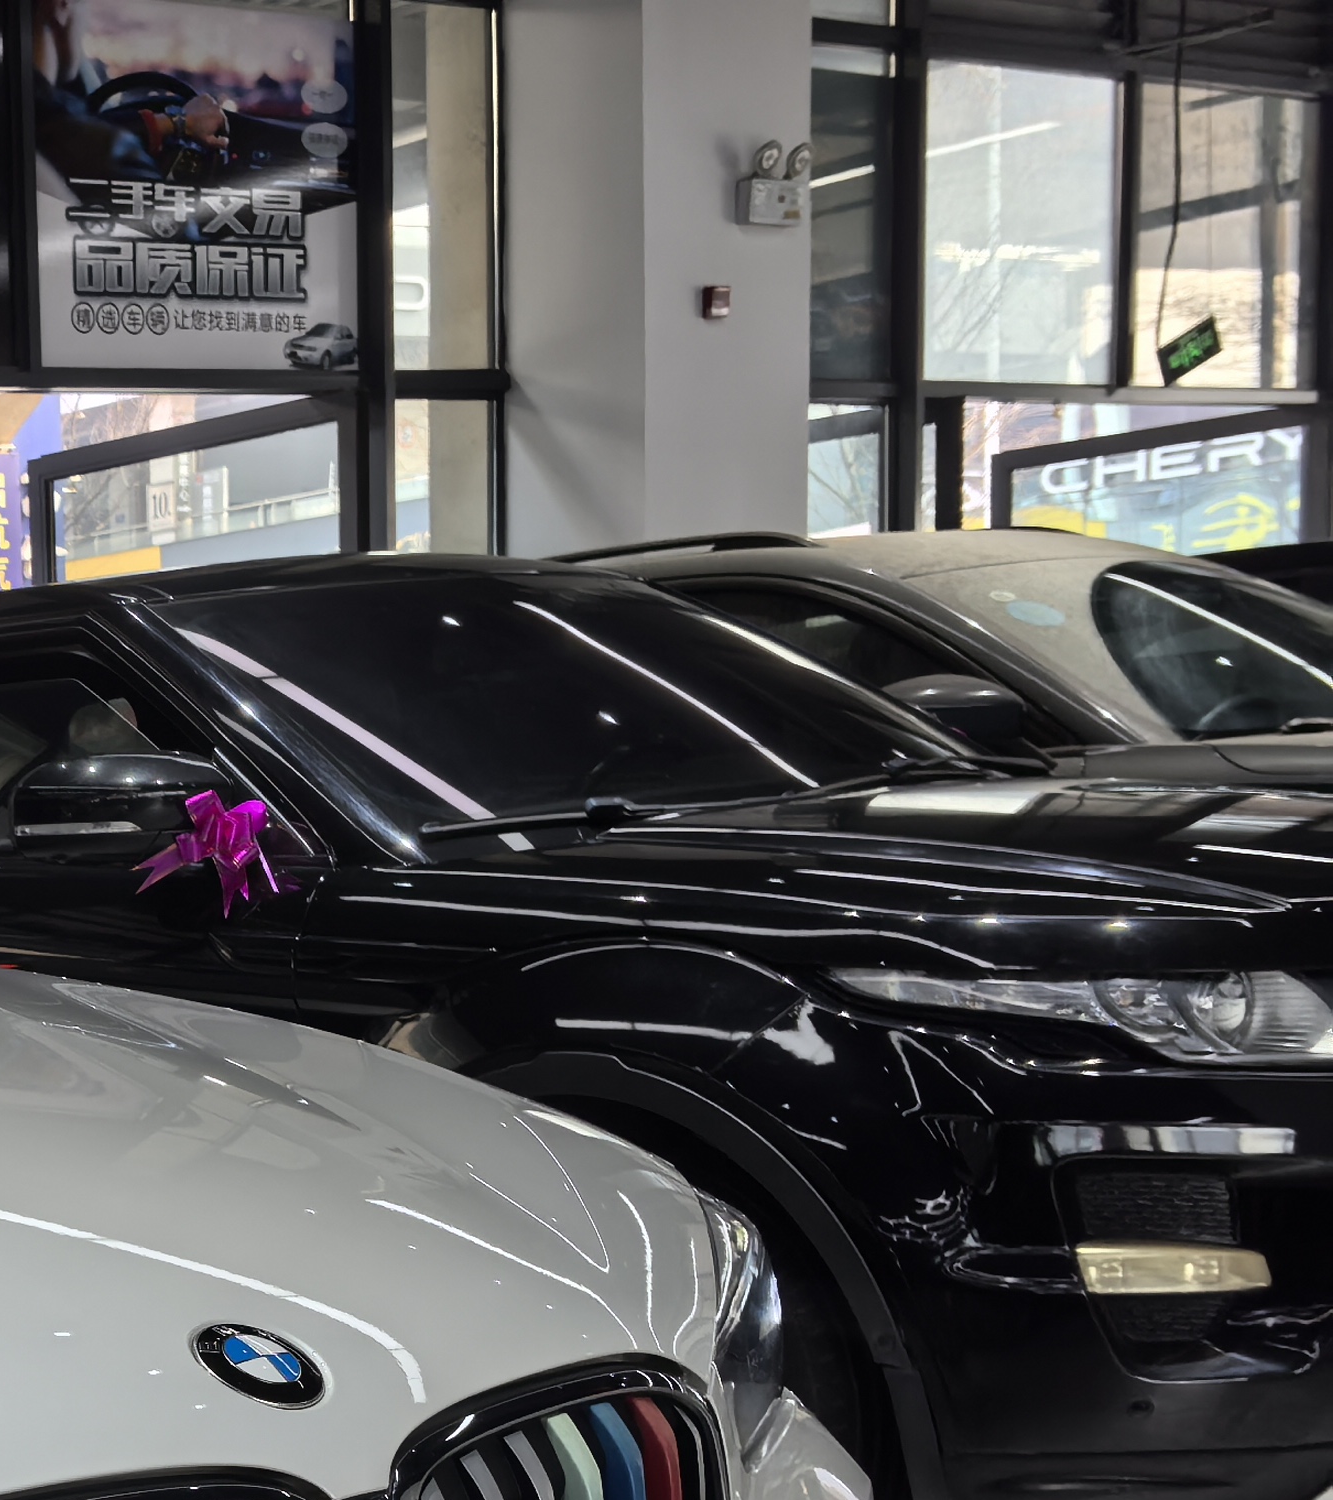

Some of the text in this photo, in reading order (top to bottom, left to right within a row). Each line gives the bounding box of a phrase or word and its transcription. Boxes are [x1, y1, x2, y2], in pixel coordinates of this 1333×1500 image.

[69, 177, 303, 238] 二手车交易
[75, 239, 306, 298] 品质保证
[1040, 425, 1303, 494] CHERY
